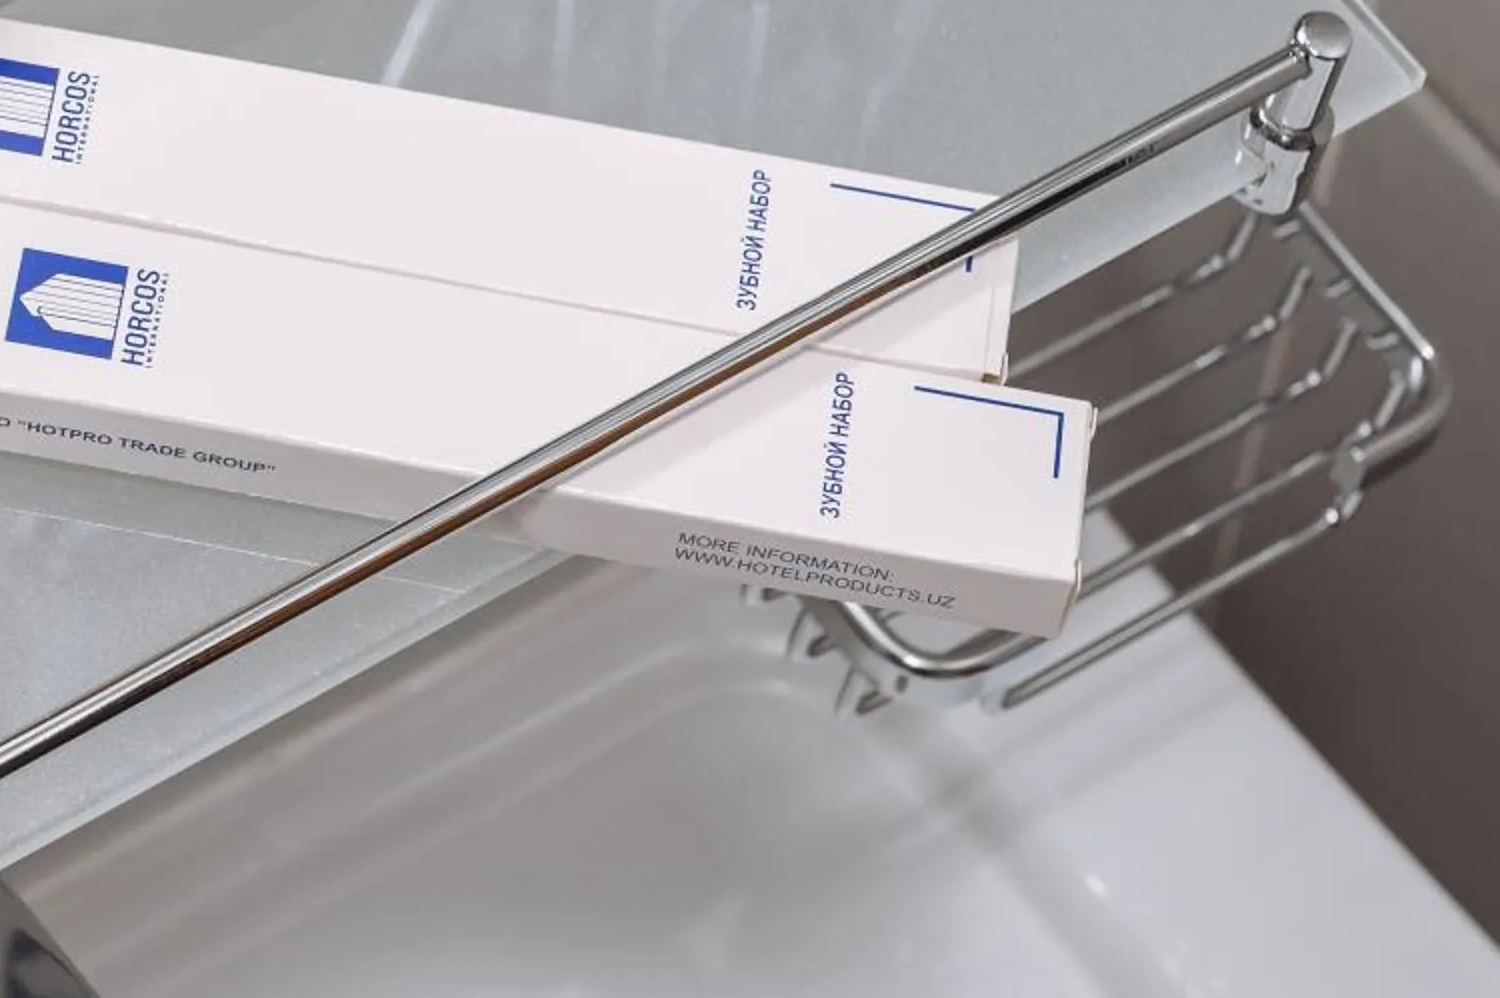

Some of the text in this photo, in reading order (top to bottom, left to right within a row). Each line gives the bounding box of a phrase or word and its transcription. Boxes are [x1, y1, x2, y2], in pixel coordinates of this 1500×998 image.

[52, 71, 91, 163] HORCOS
[736, 169, 773, 311] ЗУБНОЙ НАБОР
[120, 268, 161, 366] HORCOS
[119, 437, 187, 458] TRADE
[820, 372, 856, 519] ЗУБНОЙ НАБОР
[674, 547, 957, 609] WWW.HOTELPRODUCTS.UZ
[678, 532, 895, 580] MORE INFORMATION:
